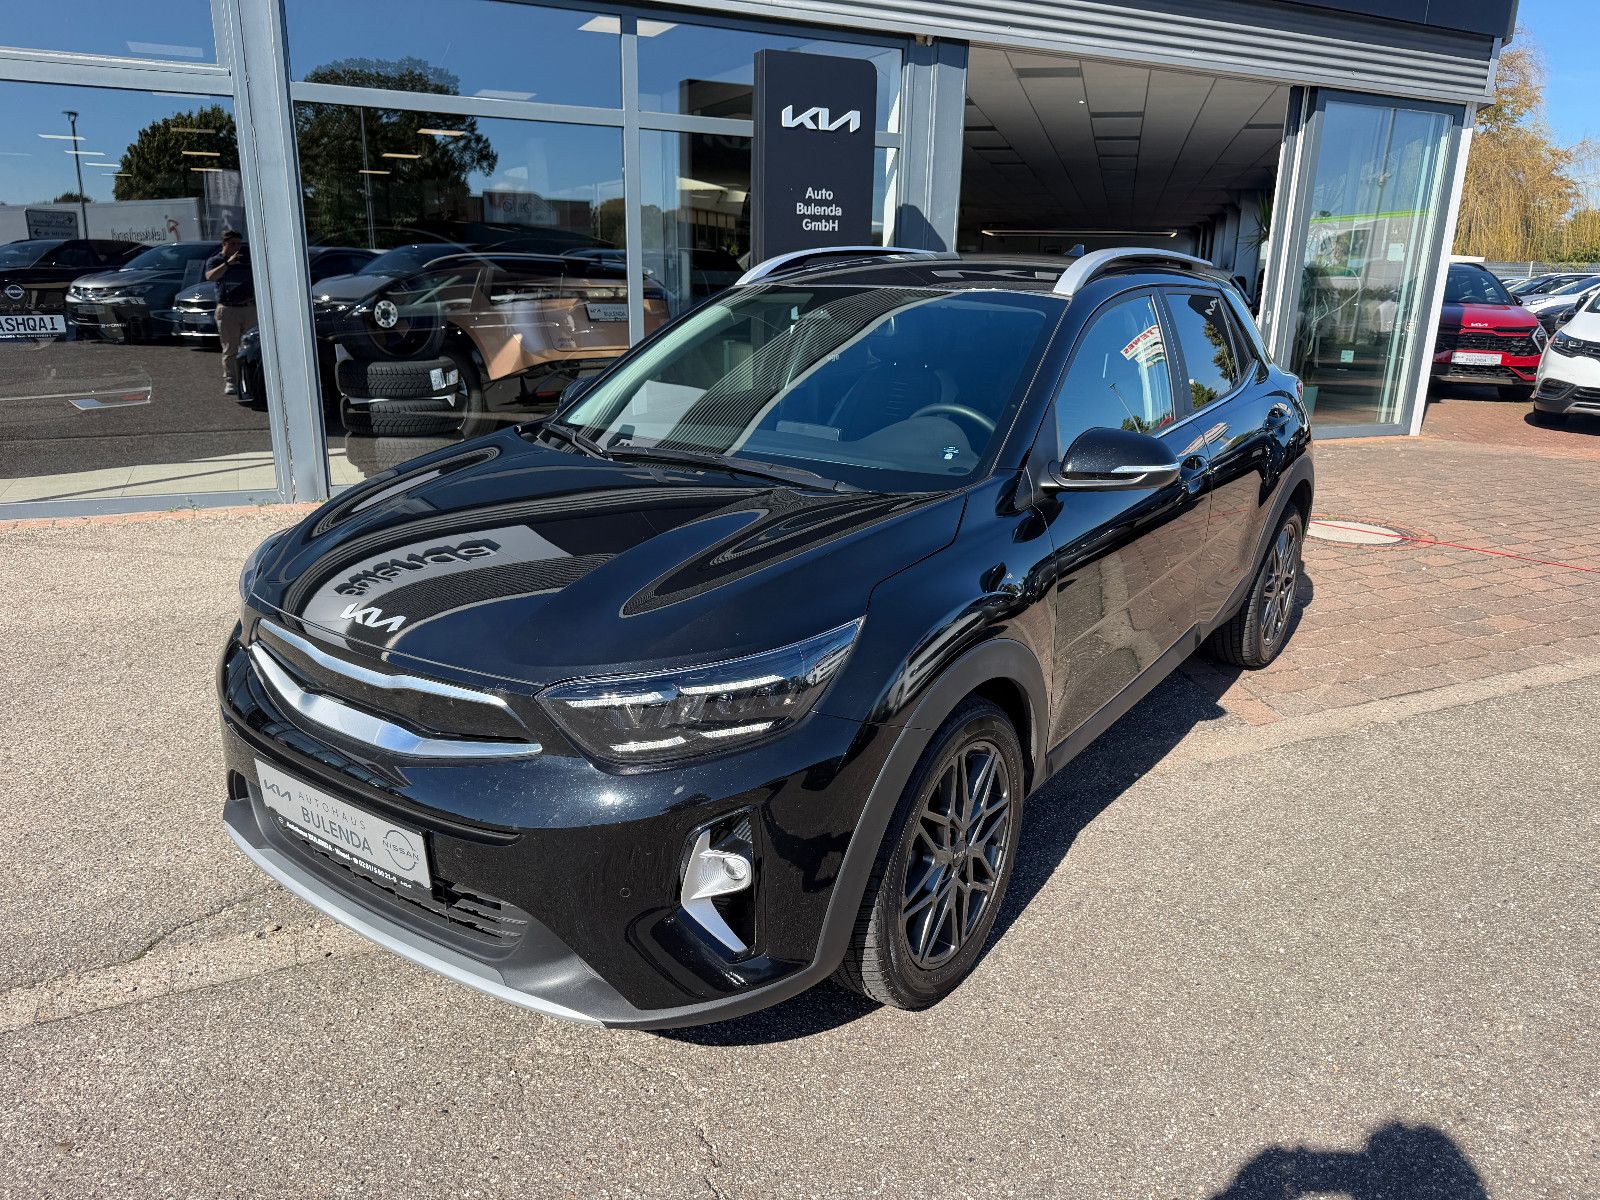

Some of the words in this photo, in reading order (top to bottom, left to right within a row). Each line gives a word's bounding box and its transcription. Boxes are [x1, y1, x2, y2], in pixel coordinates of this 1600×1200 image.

[781, 104, 861, 133] KIA
[805, 186, 834, 200] Auto
[796, 202, 842, 216] Bulenda
[802, 218, 839, 232] GmbH
[340, 603, 406, 632] KIA
[263, 779, 292, 801] KIA
[298, 791, 367, 831] AUTOHAUS
[300, 805, 374, 856] BULENDA
[382, 839, 420, 862] NISSAN
